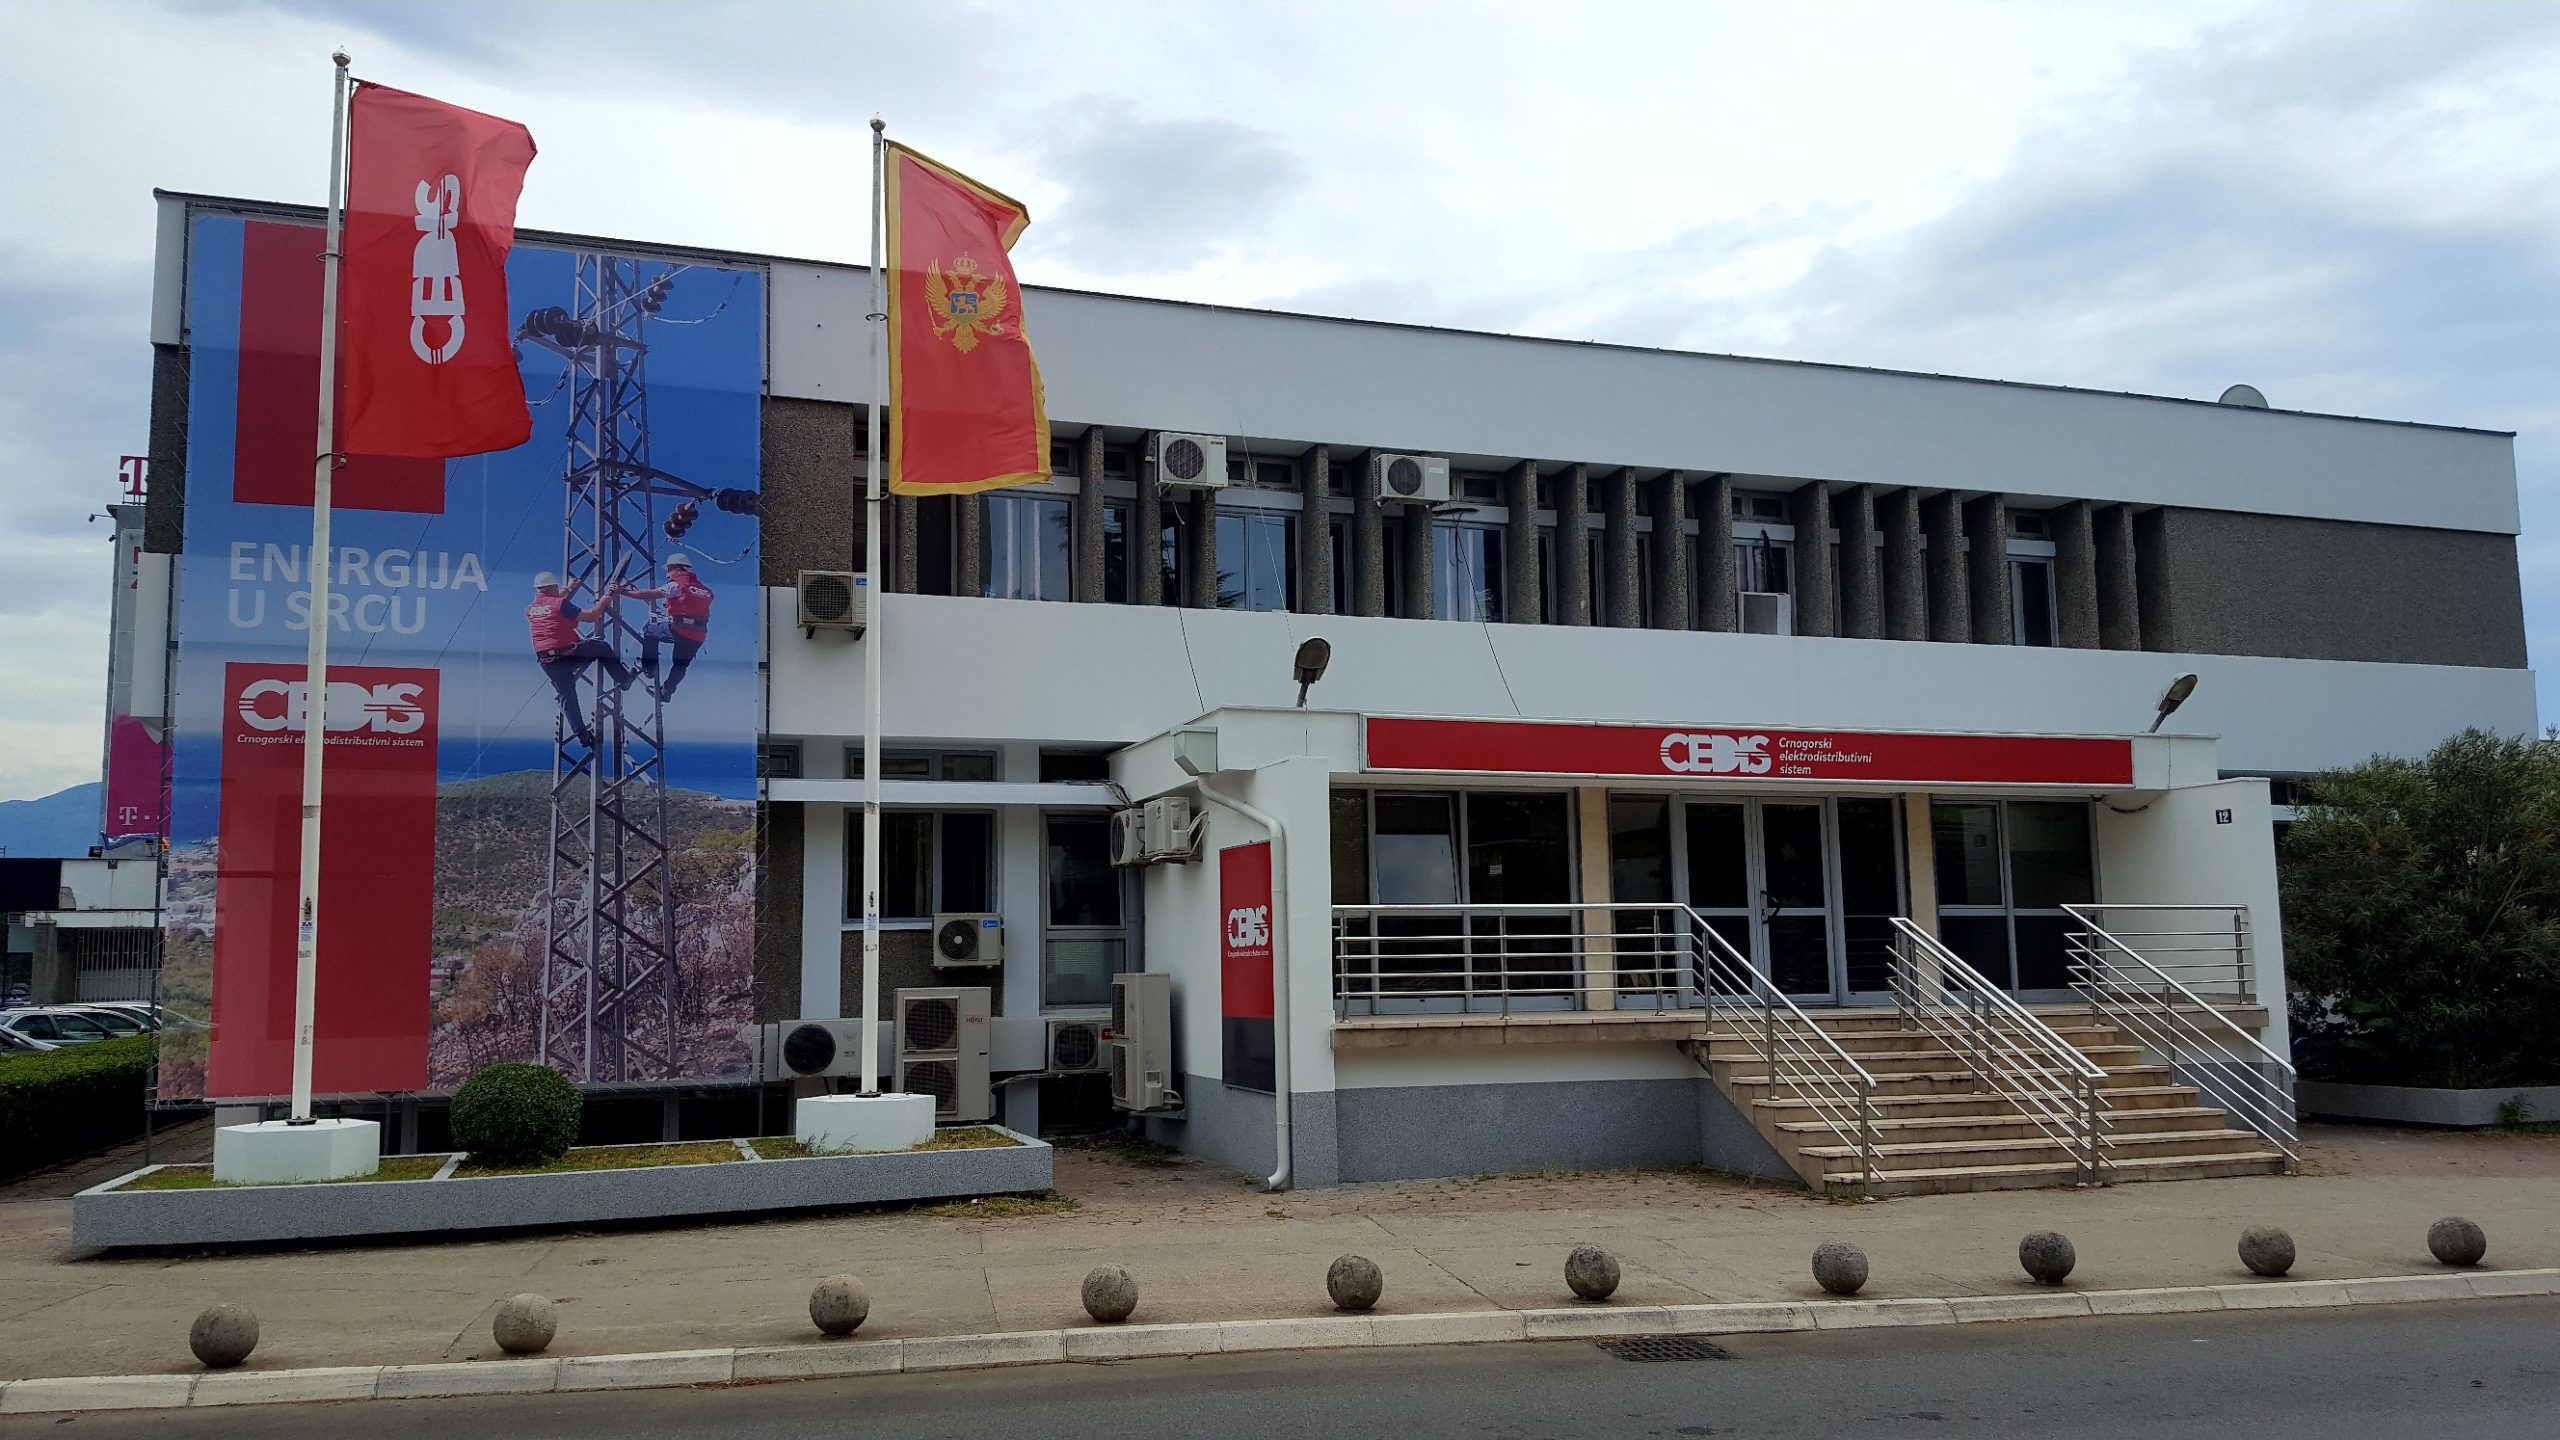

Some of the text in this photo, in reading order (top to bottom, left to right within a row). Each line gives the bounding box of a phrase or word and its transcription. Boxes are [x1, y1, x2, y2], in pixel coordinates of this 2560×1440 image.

[410, 174, 465, 364] CEDIS
[228, 589, 426, 635] U SRCU
[239, 679, 425, 734] CEDIS
[237, 734, 424, 747] Crnogorski elodistributivni sistem
[1660, 733, 1772, 774] CEDIS
[1779, 738, 1833, 751] Crnogorski
[1779, 750, 1872, 763] elektrodistributivni
[1779, 765, 1812, 775] sistem
[2218, 811, 2229, 823] 12
[1227, 904, 1269, 948] CEDIS
